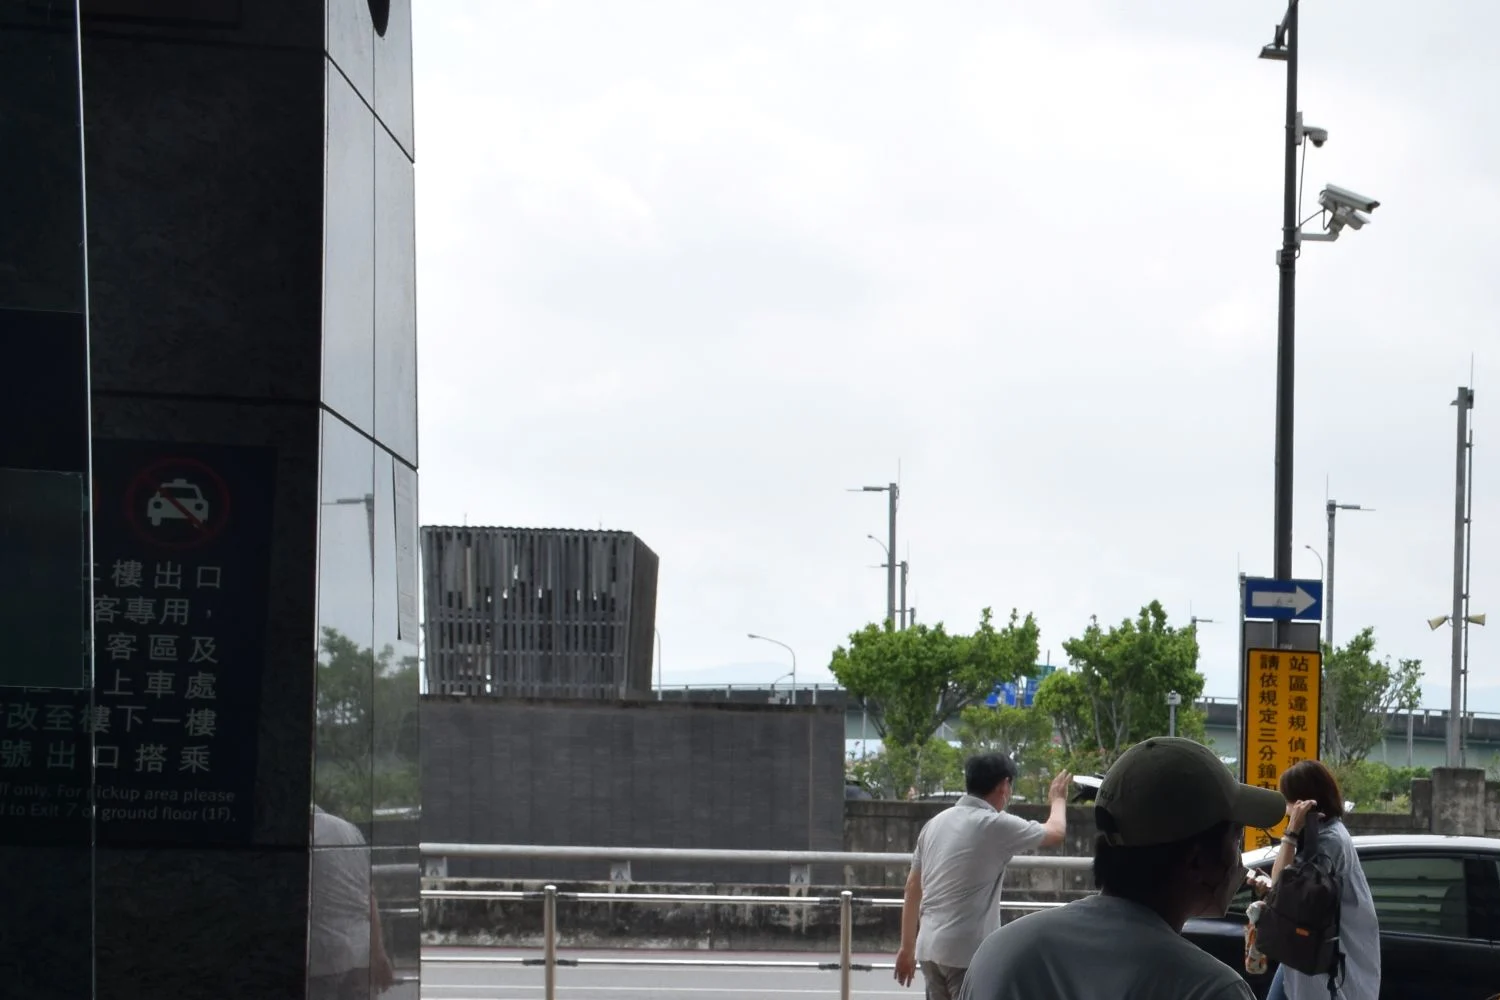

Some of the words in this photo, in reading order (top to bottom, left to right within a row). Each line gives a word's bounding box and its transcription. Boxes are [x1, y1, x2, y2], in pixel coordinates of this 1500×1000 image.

[84, 668, 217, 700] 上車處
[0, 702, 217, 737] 改至樓下一樓
[144, 788, 178, 801] area
[183, 787, 236, 804] please
[31, 802, 59, 818] Exit
[101, 805, 158, 822] ground
[162, 805, 198, 821] floor
